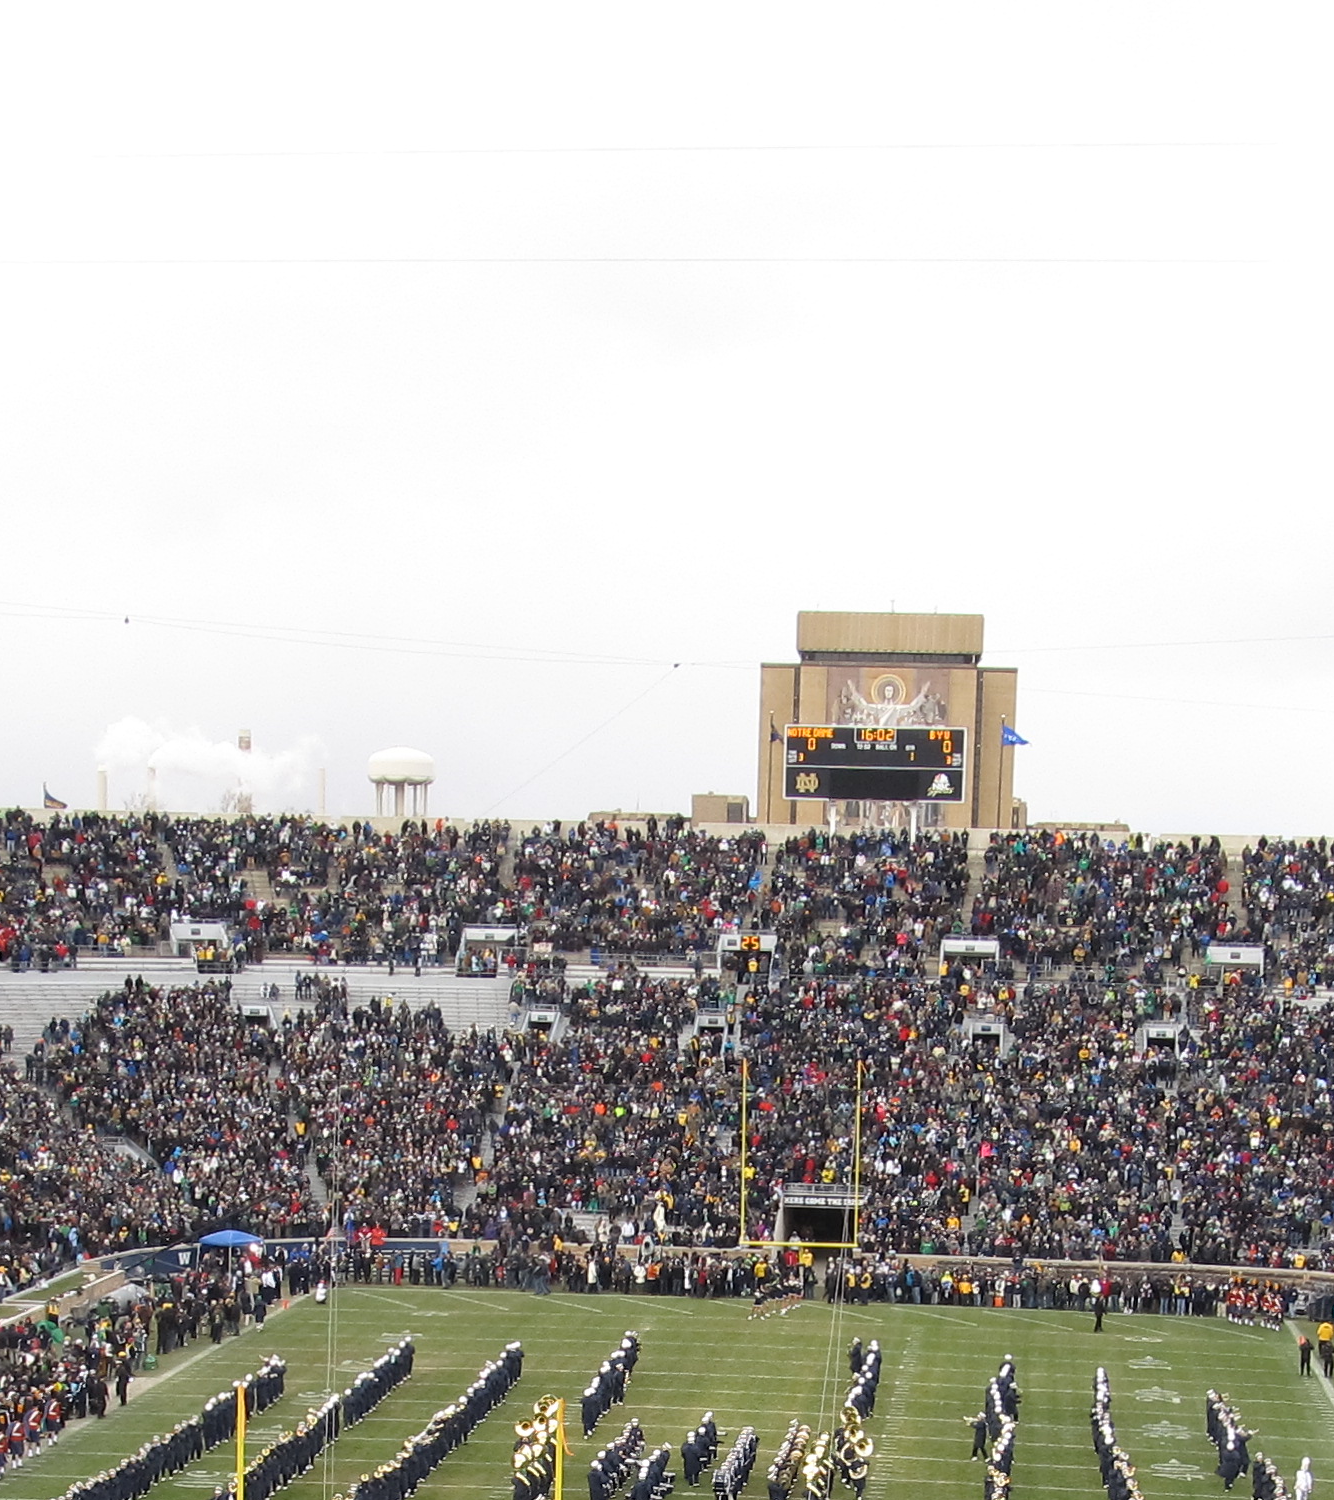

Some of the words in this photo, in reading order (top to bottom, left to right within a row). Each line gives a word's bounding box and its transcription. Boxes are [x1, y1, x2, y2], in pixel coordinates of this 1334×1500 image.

[787, 727, 811, 738] NOTRE
[813, 727, 834, 739] DAME
[861, 728, 894, 741] 16:02
[929, 730, 951, 740] BYU
[807, 737, 816, 750] 0
[942, 740, 952, 753] 0
[741, 935, 760, 950] 25
[178, 1252, 192, 1265] W
